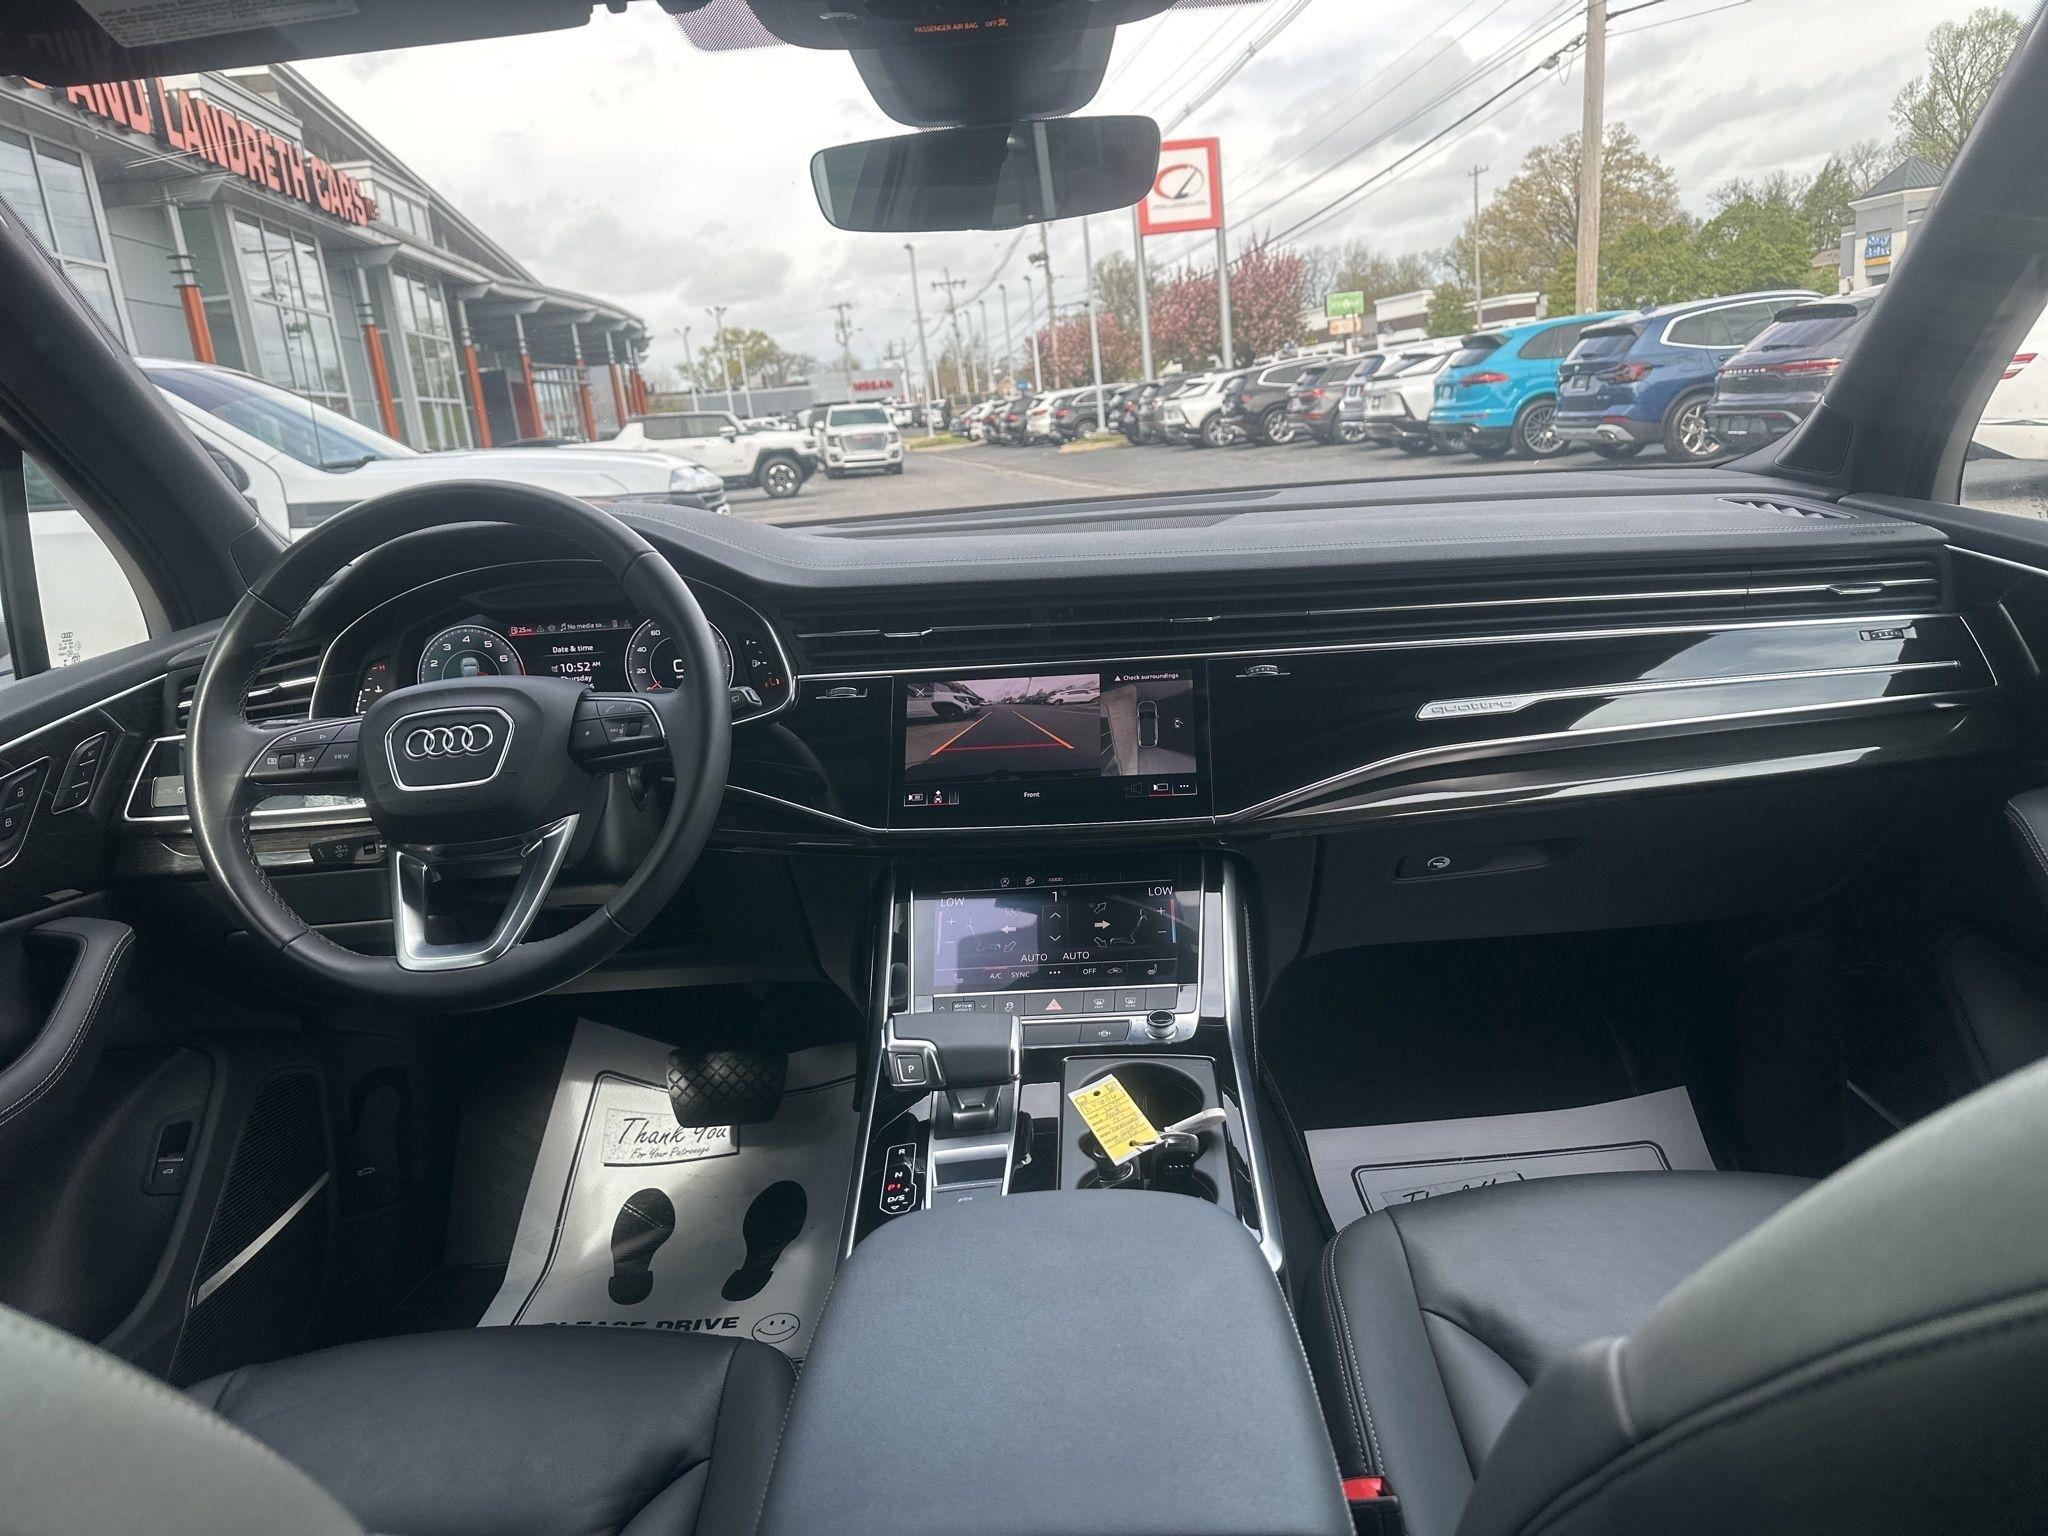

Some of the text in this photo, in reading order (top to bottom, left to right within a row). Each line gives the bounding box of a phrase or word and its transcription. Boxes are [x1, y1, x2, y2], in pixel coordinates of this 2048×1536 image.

[914, 20, 998, 33] PASSENGER AIR BAG OFF
[155, 76, 311, 204] LANDRETH
[311, 156, 369, 228] CARS
[577, 622, 595, 630] media
[650, 628, 661, 636] 60
[462, 635, 471, 643] 4
[442, 643, 452, 651] 3
[483, 640, 493, 648] 5
[552, 644, 594, 654] Date & time
[430, 659, 439, 668] 2
[499, 655, 509, 663] 6
[560, 661, 591, 673] 10:52
[1141, 672, 1179, 680] surroundings
[1431, 701, 1512, 715] quattro
[1023, 791, 1041, 799] Front
[1148, 886, 1173, 897] LOW
[940, 897, 966, 908] LOW
[1020, 951, 1090, 963] AUTO AUTO
[989, 971, 1030, 980] A/C SYNC
[1082, 967, 1097, 976] OFF
[908, 1064, 915, 1074] P
[618, 1117, 727, 1145] Thank You
[630, 1146, 711, 1159] For Your Patronage
[894, 1171, 903, 1179] N
[887, 1194, 906, 1203] D/S
[656, 1316, 740, 1332] DRIVE
